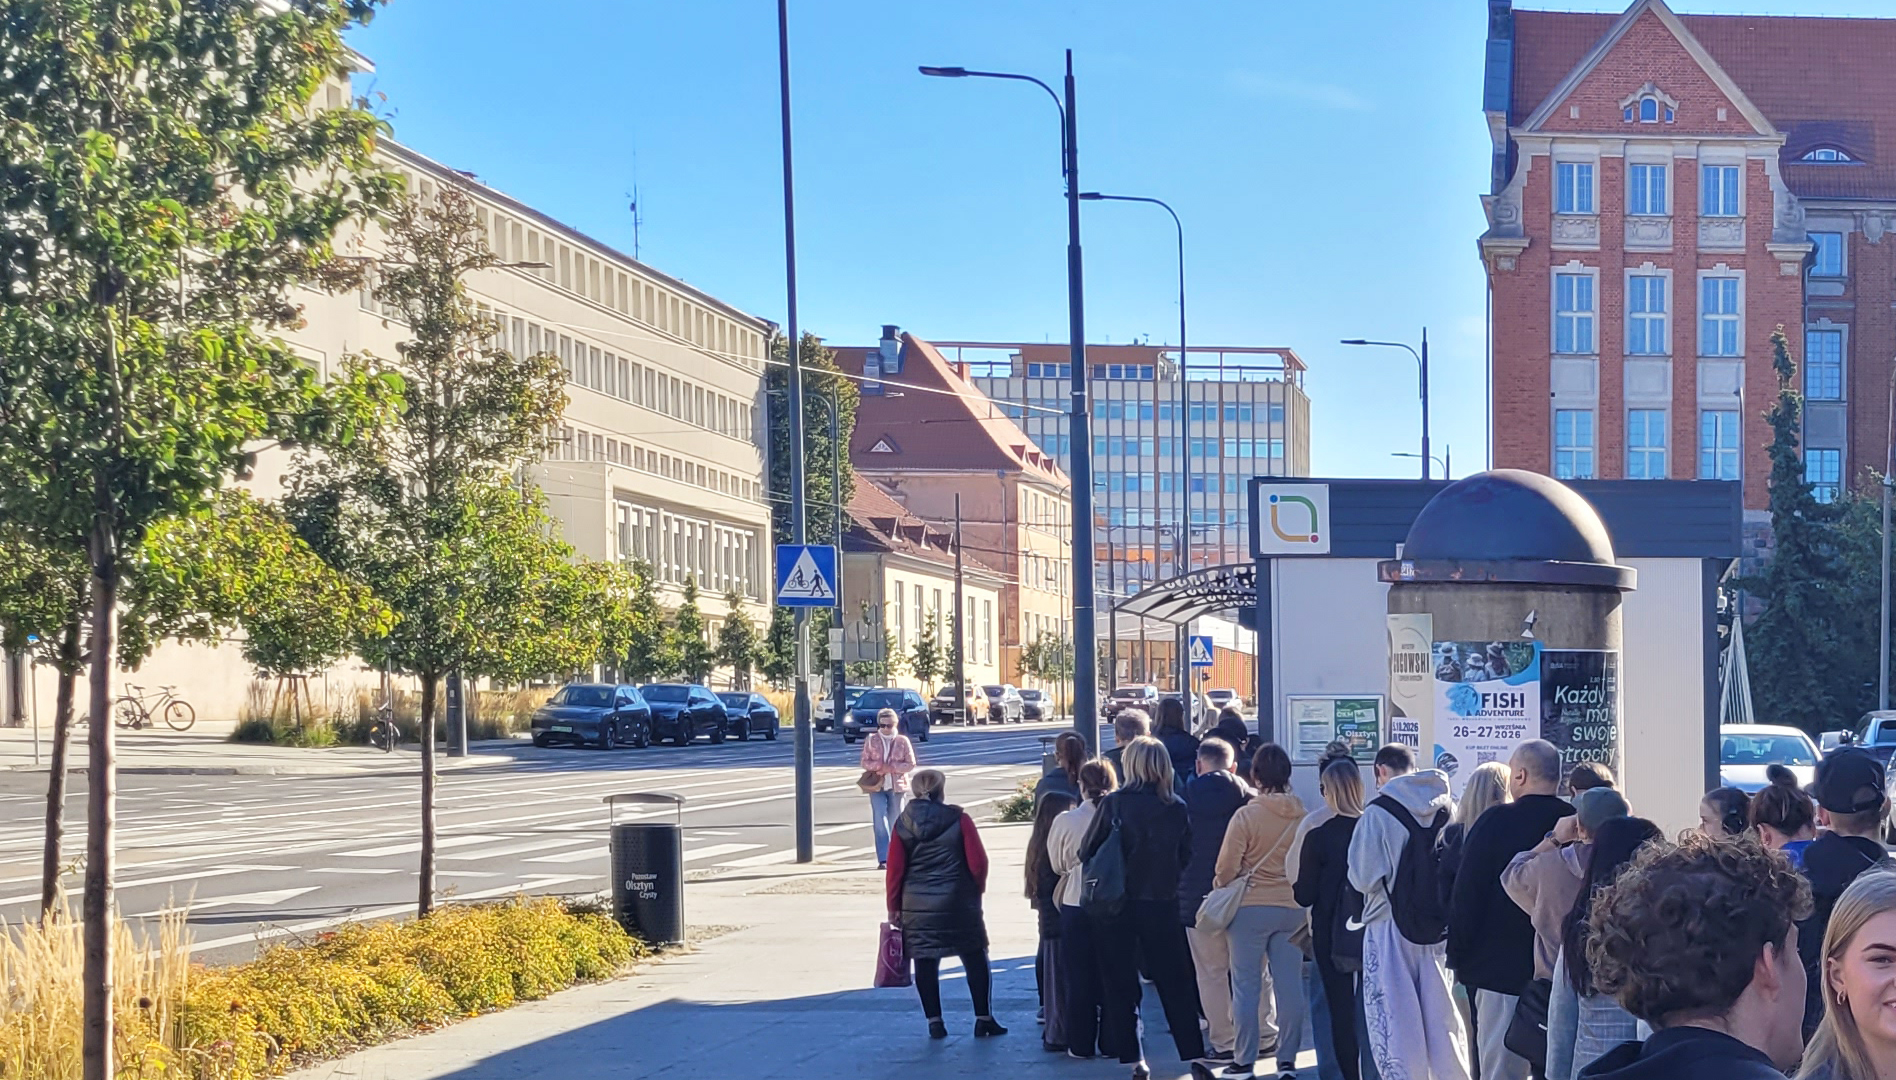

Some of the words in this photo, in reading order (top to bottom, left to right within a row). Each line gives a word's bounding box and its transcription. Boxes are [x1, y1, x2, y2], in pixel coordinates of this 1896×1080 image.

[1481, 693, 1525, 708] FISH
[1554, 685, 1605, 708] Każdy
[1586, 708, 1608, 722] ma
[1345, 730, 1377, 738] Olsztyn
[1495, 731, 1521, 739] 2026
[1572, 721, 1617, 745] swoje
[625, 880, 654, 892] Olsztyn
